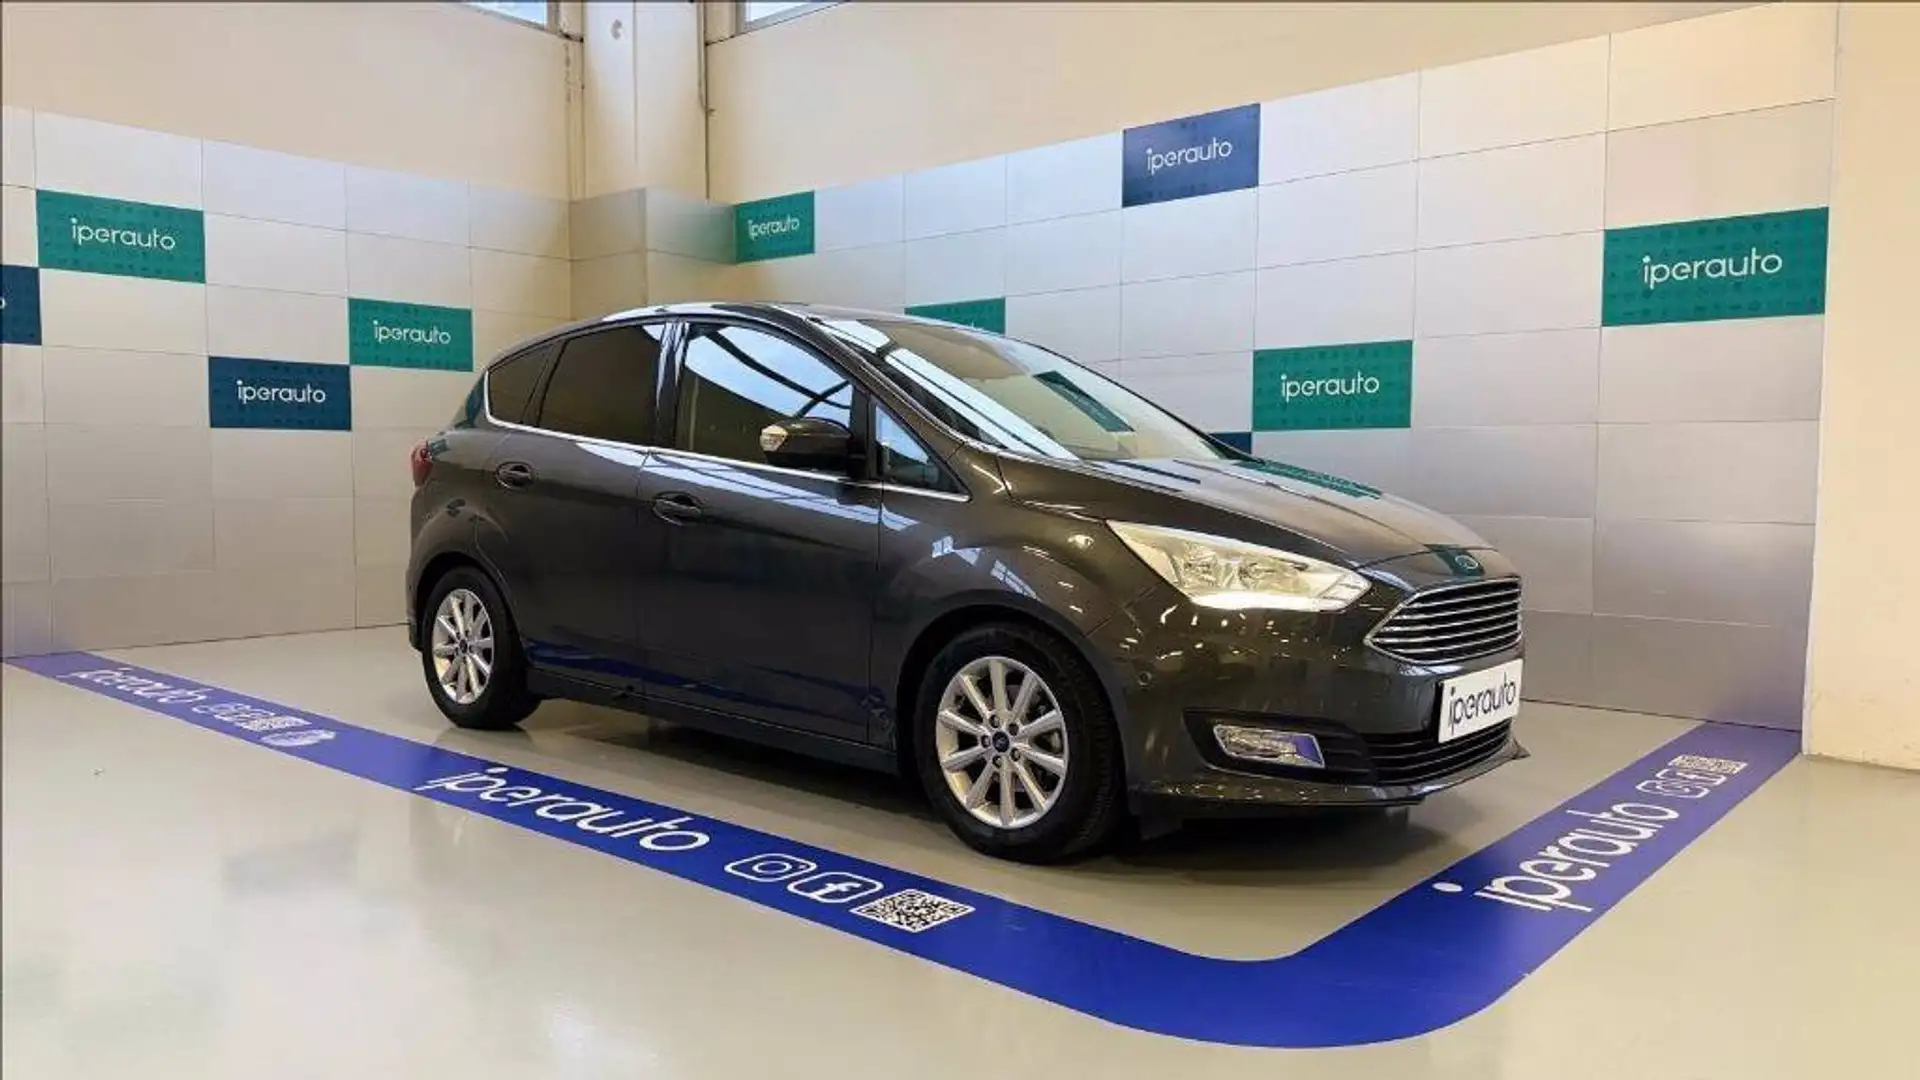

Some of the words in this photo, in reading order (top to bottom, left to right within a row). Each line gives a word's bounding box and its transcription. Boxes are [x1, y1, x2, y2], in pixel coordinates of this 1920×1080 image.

[1146, 138, 1233, 176] iperauto
[71, 217, 176, 251] iperauto
[747, 214, 800, 241] iperauto
[1642, 247, 1783, 289] iperauto
[373, 319, 452, 345] iperauto
[237, 379, 326, 404] iperauto
[1280, 371, 1380, 402] iperauto
[1448, 671, 1516, 736] iperauto
[415, 767, 710, 852] iperauto
[1433, 802, 1680, 913] iperauto
